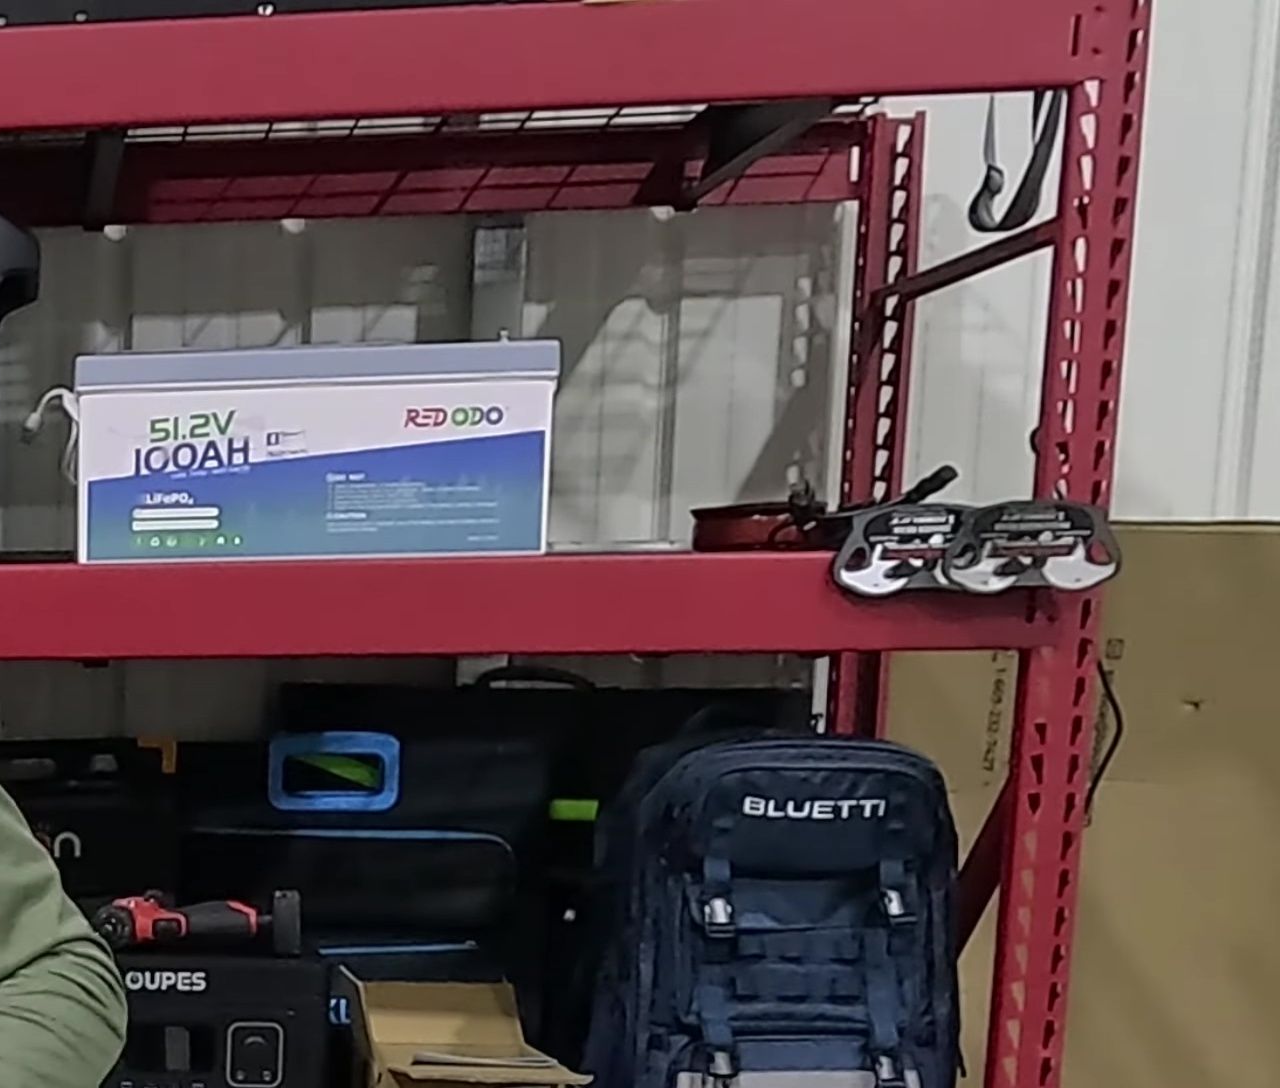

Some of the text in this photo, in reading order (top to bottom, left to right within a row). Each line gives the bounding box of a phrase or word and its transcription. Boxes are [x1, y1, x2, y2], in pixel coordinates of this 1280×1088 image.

[149, 409, 237, 444] 51.2V
[742, 795, 887, 820] BLUETTI
[124, 970, 208, 992] OUPES
